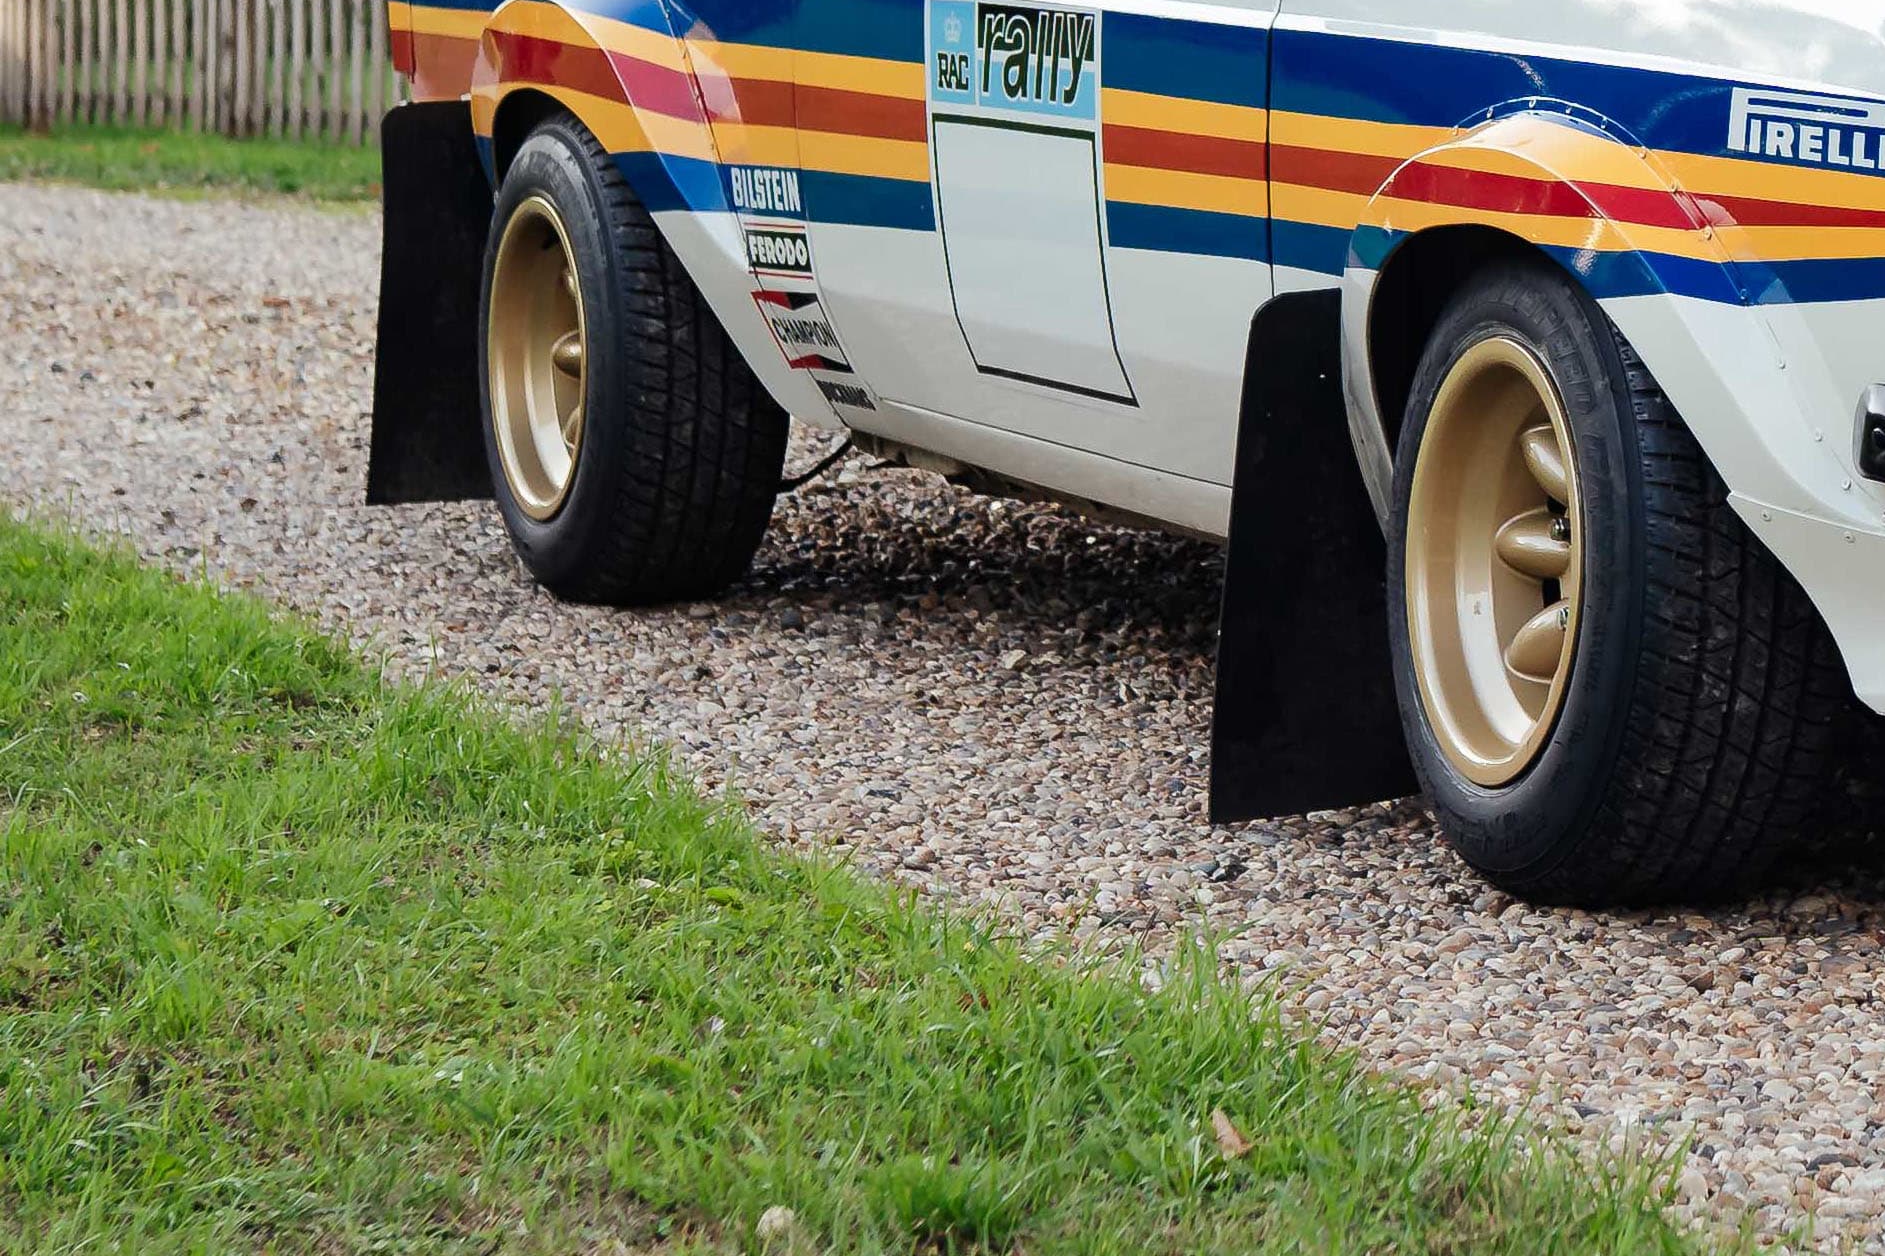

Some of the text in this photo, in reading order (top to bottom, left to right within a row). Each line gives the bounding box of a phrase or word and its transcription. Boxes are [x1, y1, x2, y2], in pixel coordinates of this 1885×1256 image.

[937, 51, 970, 92] RAC
[981, 11, 1095, 107] rally
[731, 166, 801, 213] BILSTEIN
[750, 237, 809, 267] FERODO
[771, 317, 841, 348] CHAMPION
